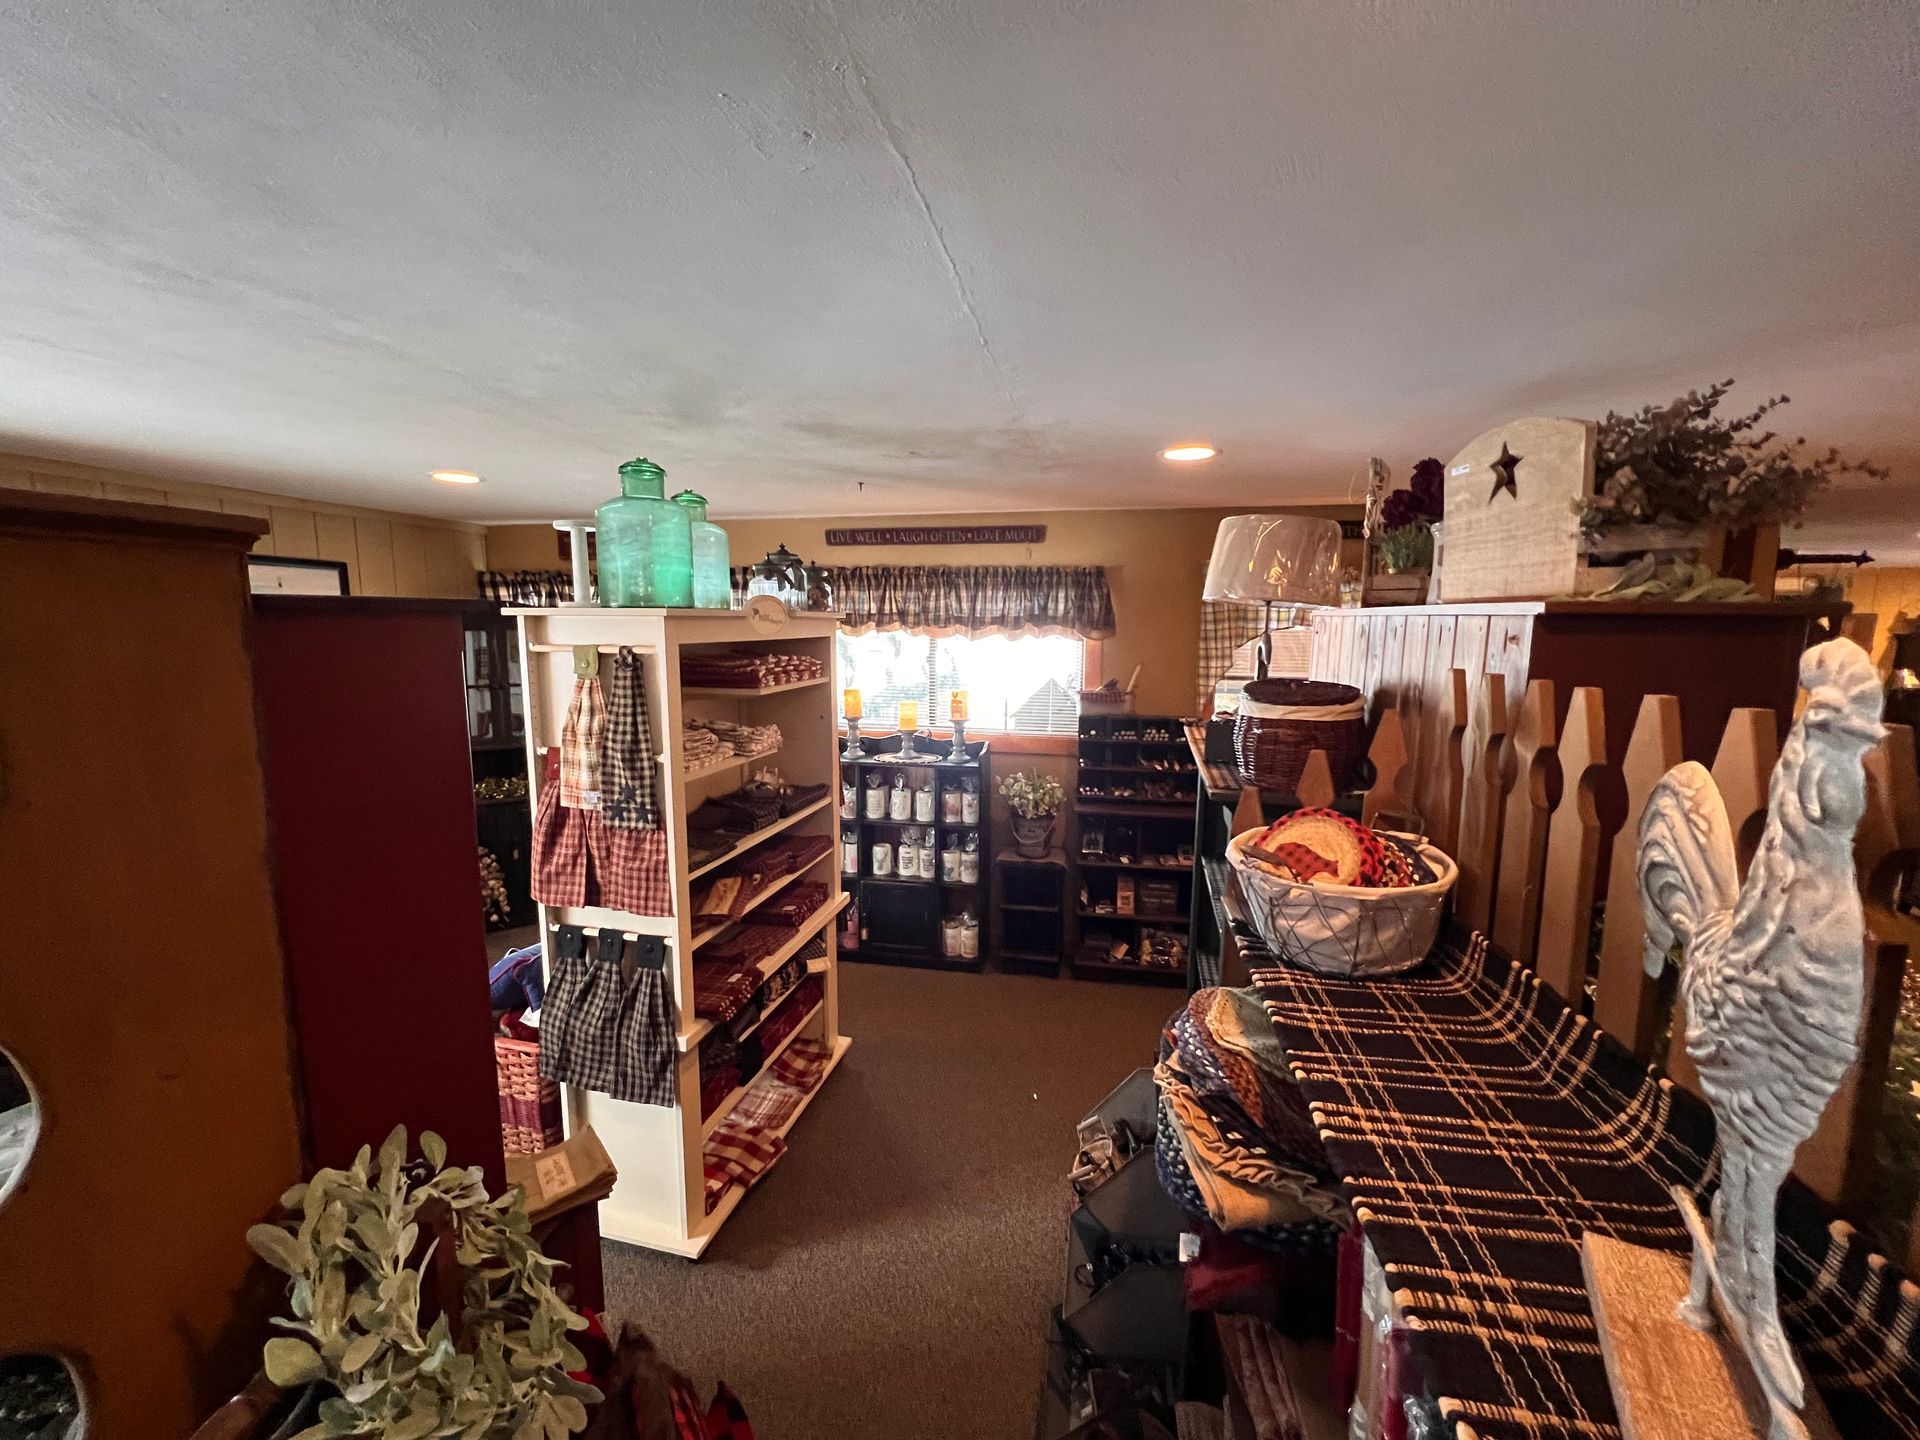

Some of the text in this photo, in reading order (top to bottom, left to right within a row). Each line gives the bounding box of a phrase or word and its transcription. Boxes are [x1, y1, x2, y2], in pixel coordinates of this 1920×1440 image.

[830, 528, 1036, 543] LIVE WELL LAUGH OFTEN LOVE MUCH
